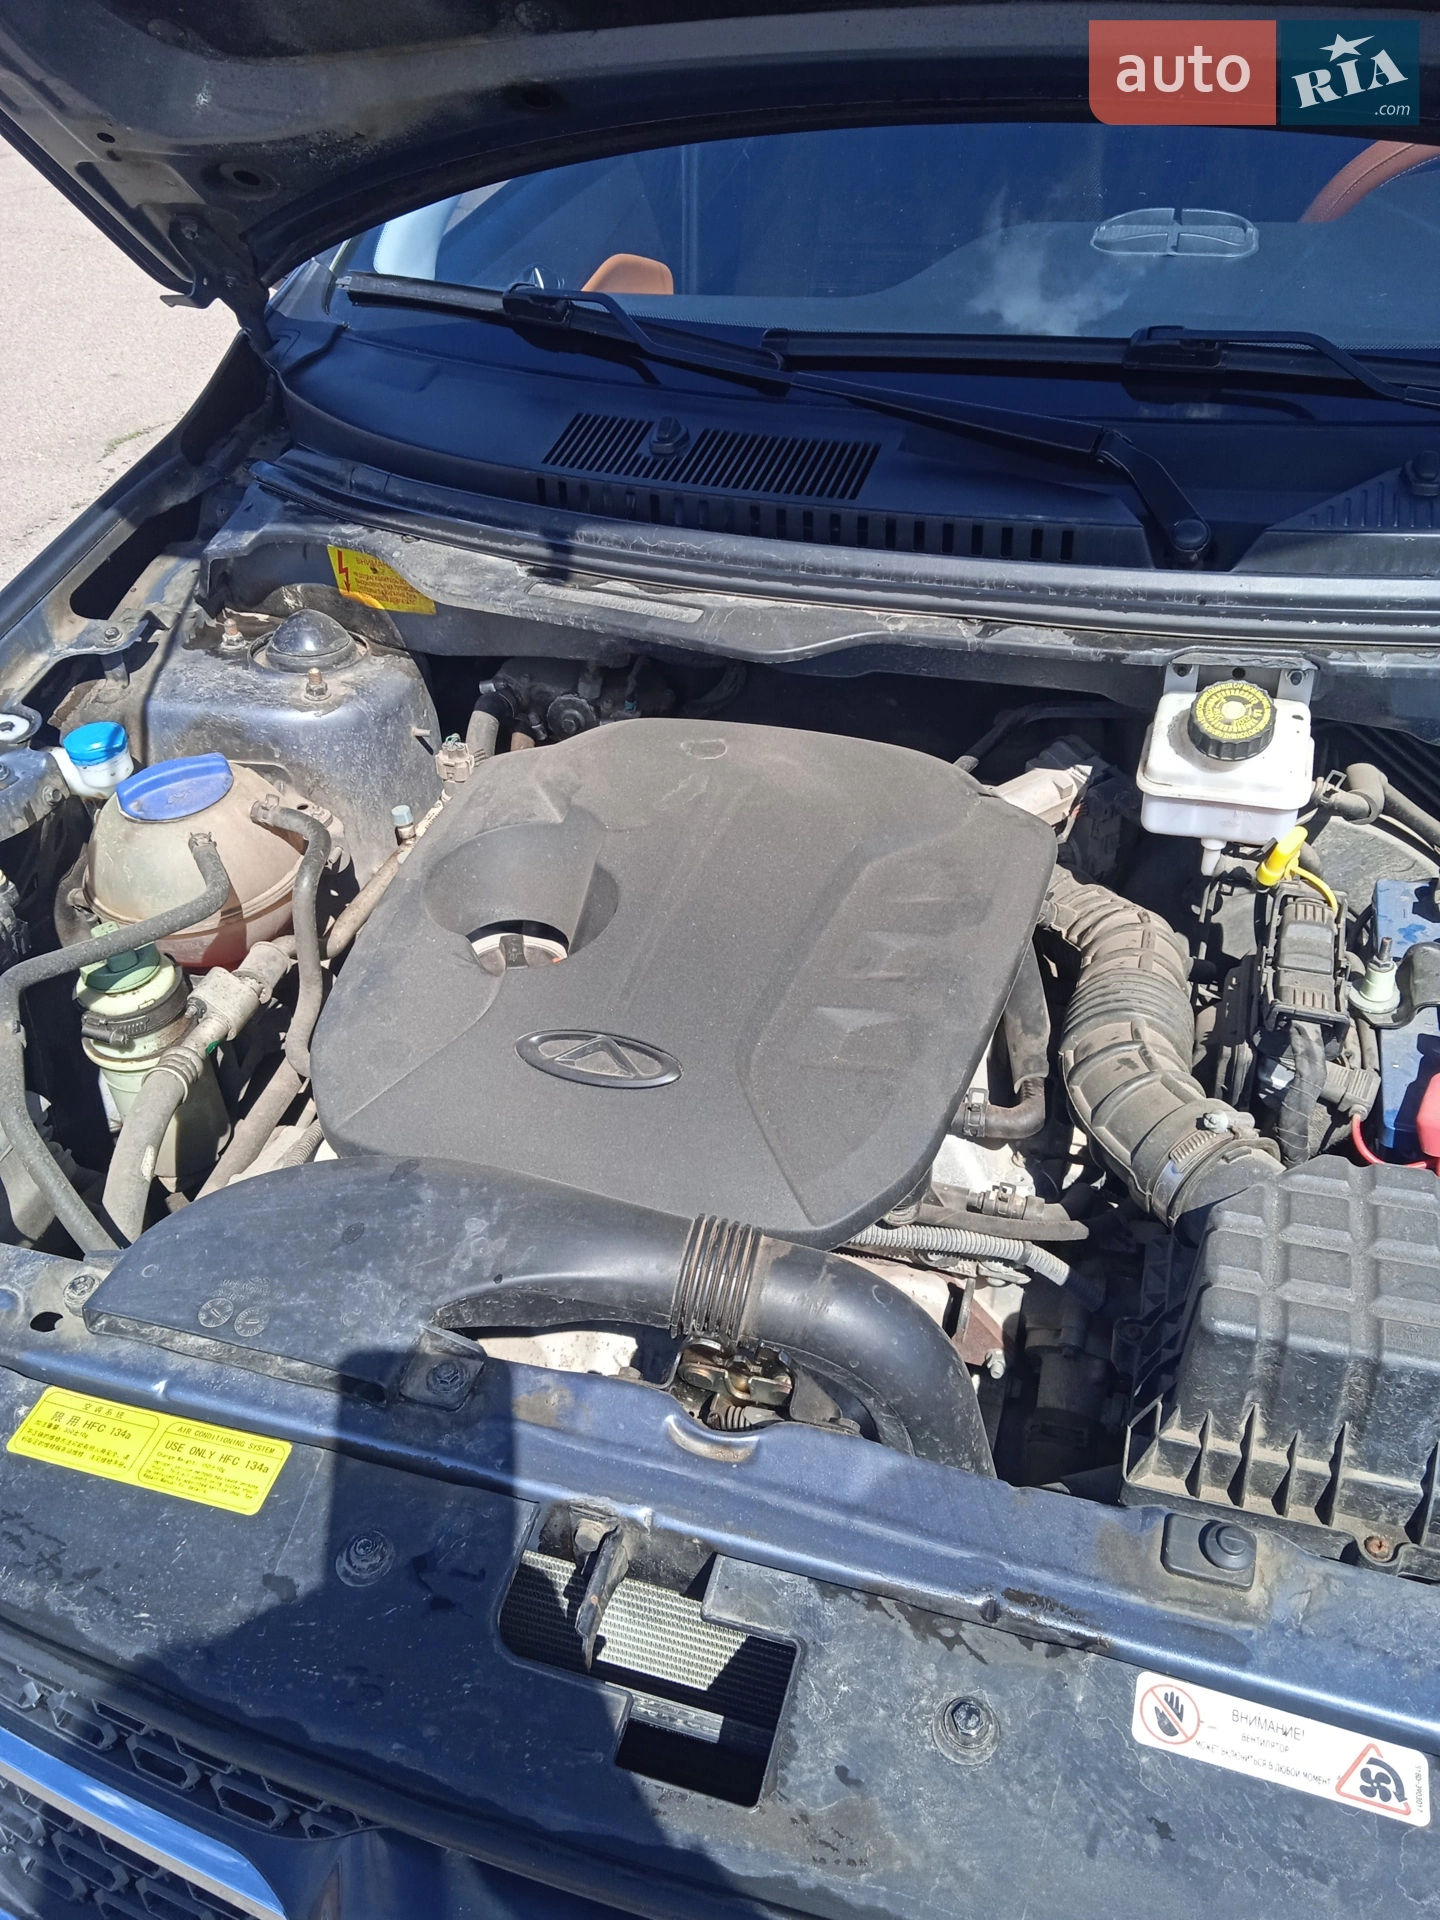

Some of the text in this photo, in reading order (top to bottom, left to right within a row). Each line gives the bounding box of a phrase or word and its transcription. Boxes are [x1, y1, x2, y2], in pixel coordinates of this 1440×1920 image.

[82, 1419, 107, 1433] HFC
[109, 1427, 132, 1440] 134a
[177, 1426, 276, 1454] AIR CONDITIONING SYSTEM
[164, 1440, 270, 1474] USE ONLY HFC 134a
[1231, 1709, 1305, 1741] ВНИМАНИЕ!
[1241, 1732, 1290, 1753] ВЕНТИЛЯТОР
[1302, 1771, 1332, 1785] МОМЕНТ
